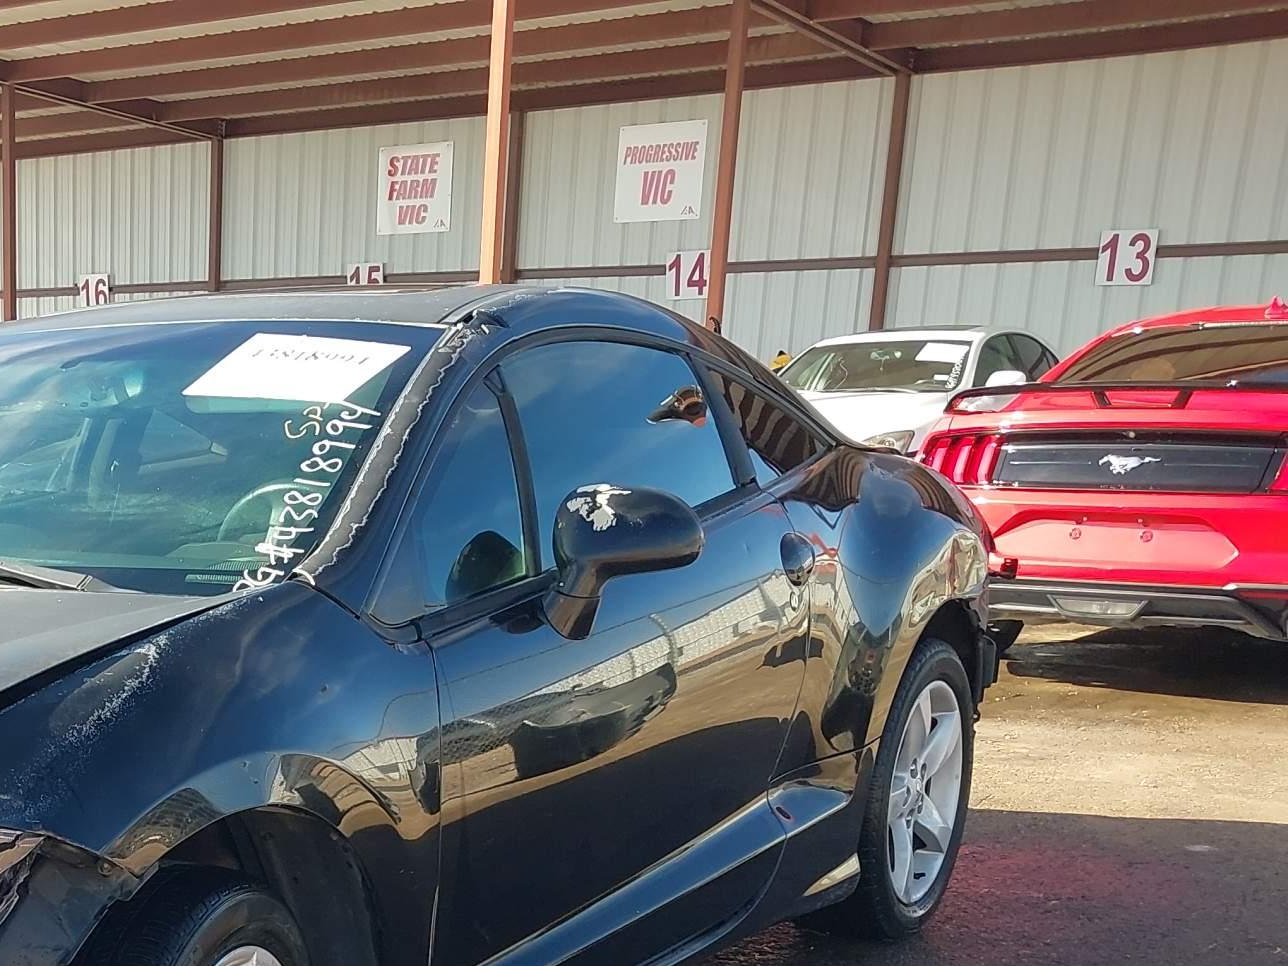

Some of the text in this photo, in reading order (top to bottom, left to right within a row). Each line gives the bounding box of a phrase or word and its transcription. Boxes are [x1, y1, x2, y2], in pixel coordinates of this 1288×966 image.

[387, 153, 441, 177] STATE
[623, 141, 700, 165] PROGRESSIVE
[387, 178, 438, 202] FARM
[640, 168, 676, 206] VIC
[397, 203, 429, 225] VIC
[1100, 232, 1152, 282] 13
[668, 252, 707, 297] 14
[81, 278, 108, 307] 16
